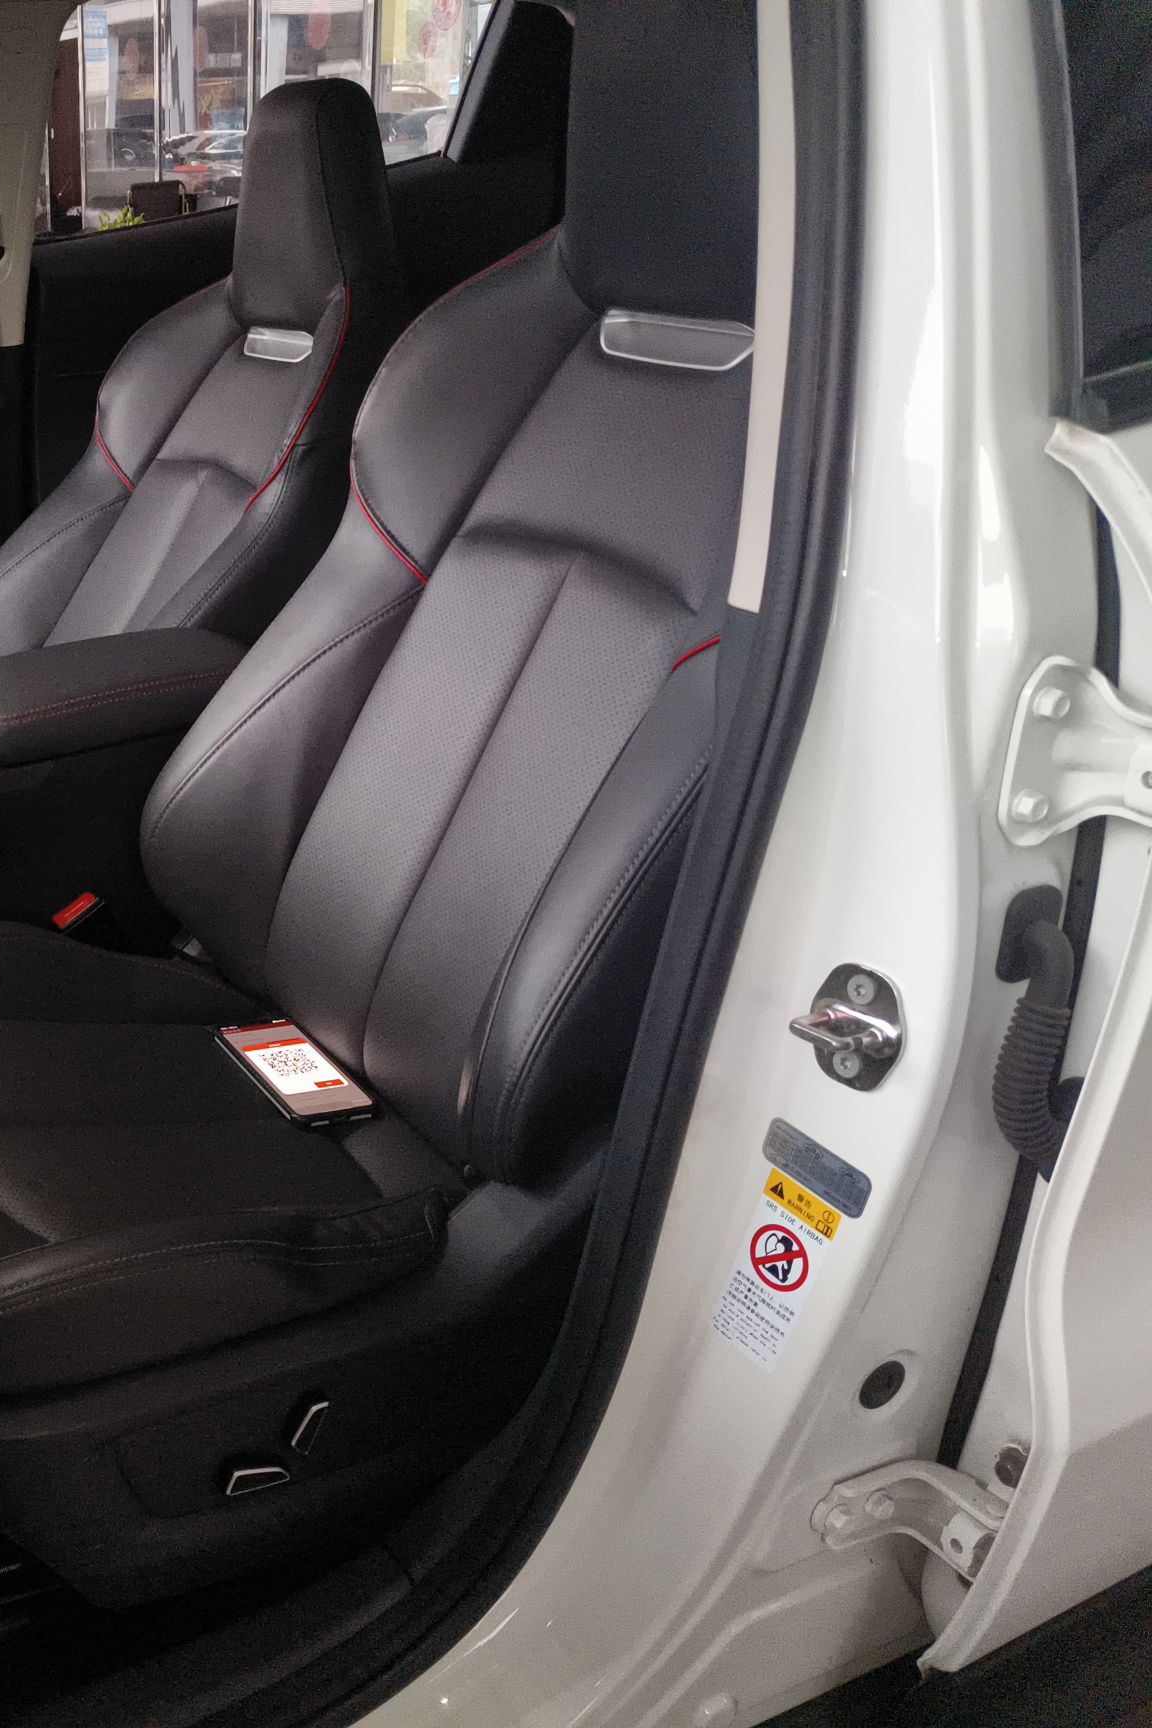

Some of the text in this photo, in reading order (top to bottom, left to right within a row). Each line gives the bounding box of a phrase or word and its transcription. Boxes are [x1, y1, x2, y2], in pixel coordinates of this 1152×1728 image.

[765, 1200, 824, 1246] SRS SIDE AIRBAG
[786, 1198, 815, 1221] WARNING
